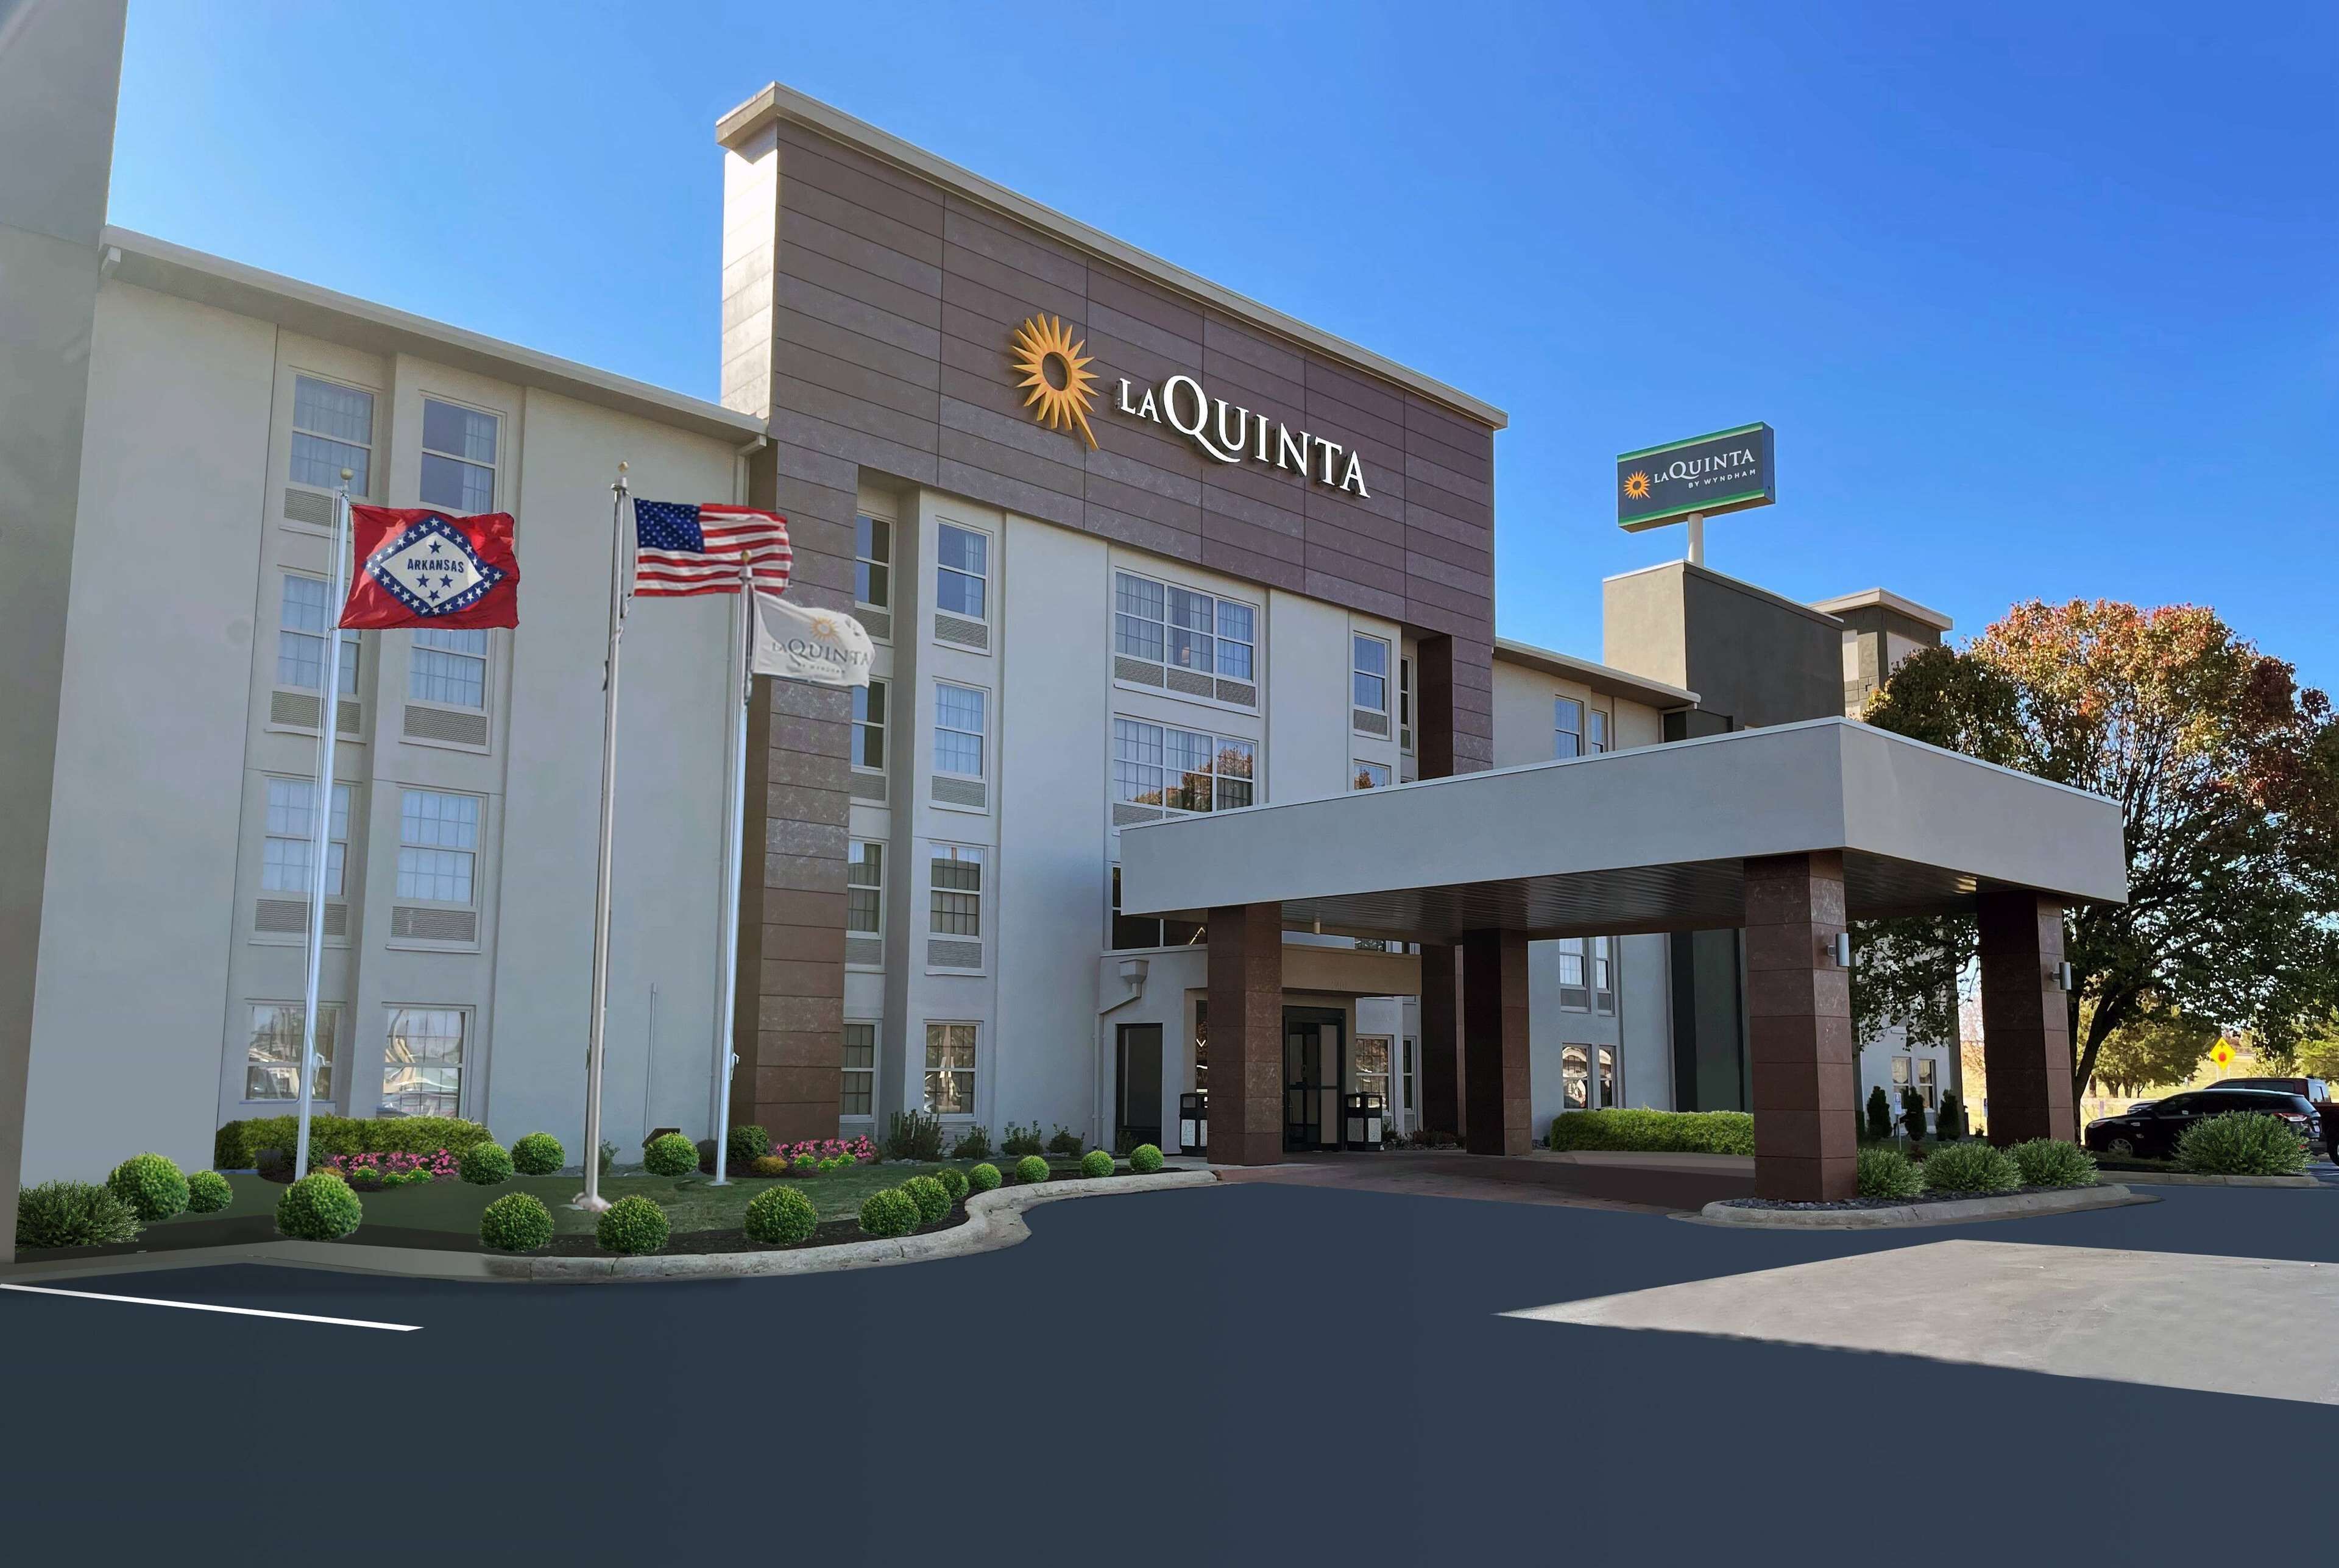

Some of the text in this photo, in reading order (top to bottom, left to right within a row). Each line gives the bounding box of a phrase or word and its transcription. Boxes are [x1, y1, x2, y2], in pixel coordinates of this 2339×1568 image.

[1117, 375, 1371, 498] LA QUINTA
[1654, 448, 1755, 483] LA QUINTA
[1688, 469, 1756, 489] BY WYNDHAM
[408, 559, 464, 573] ARKANSAS
